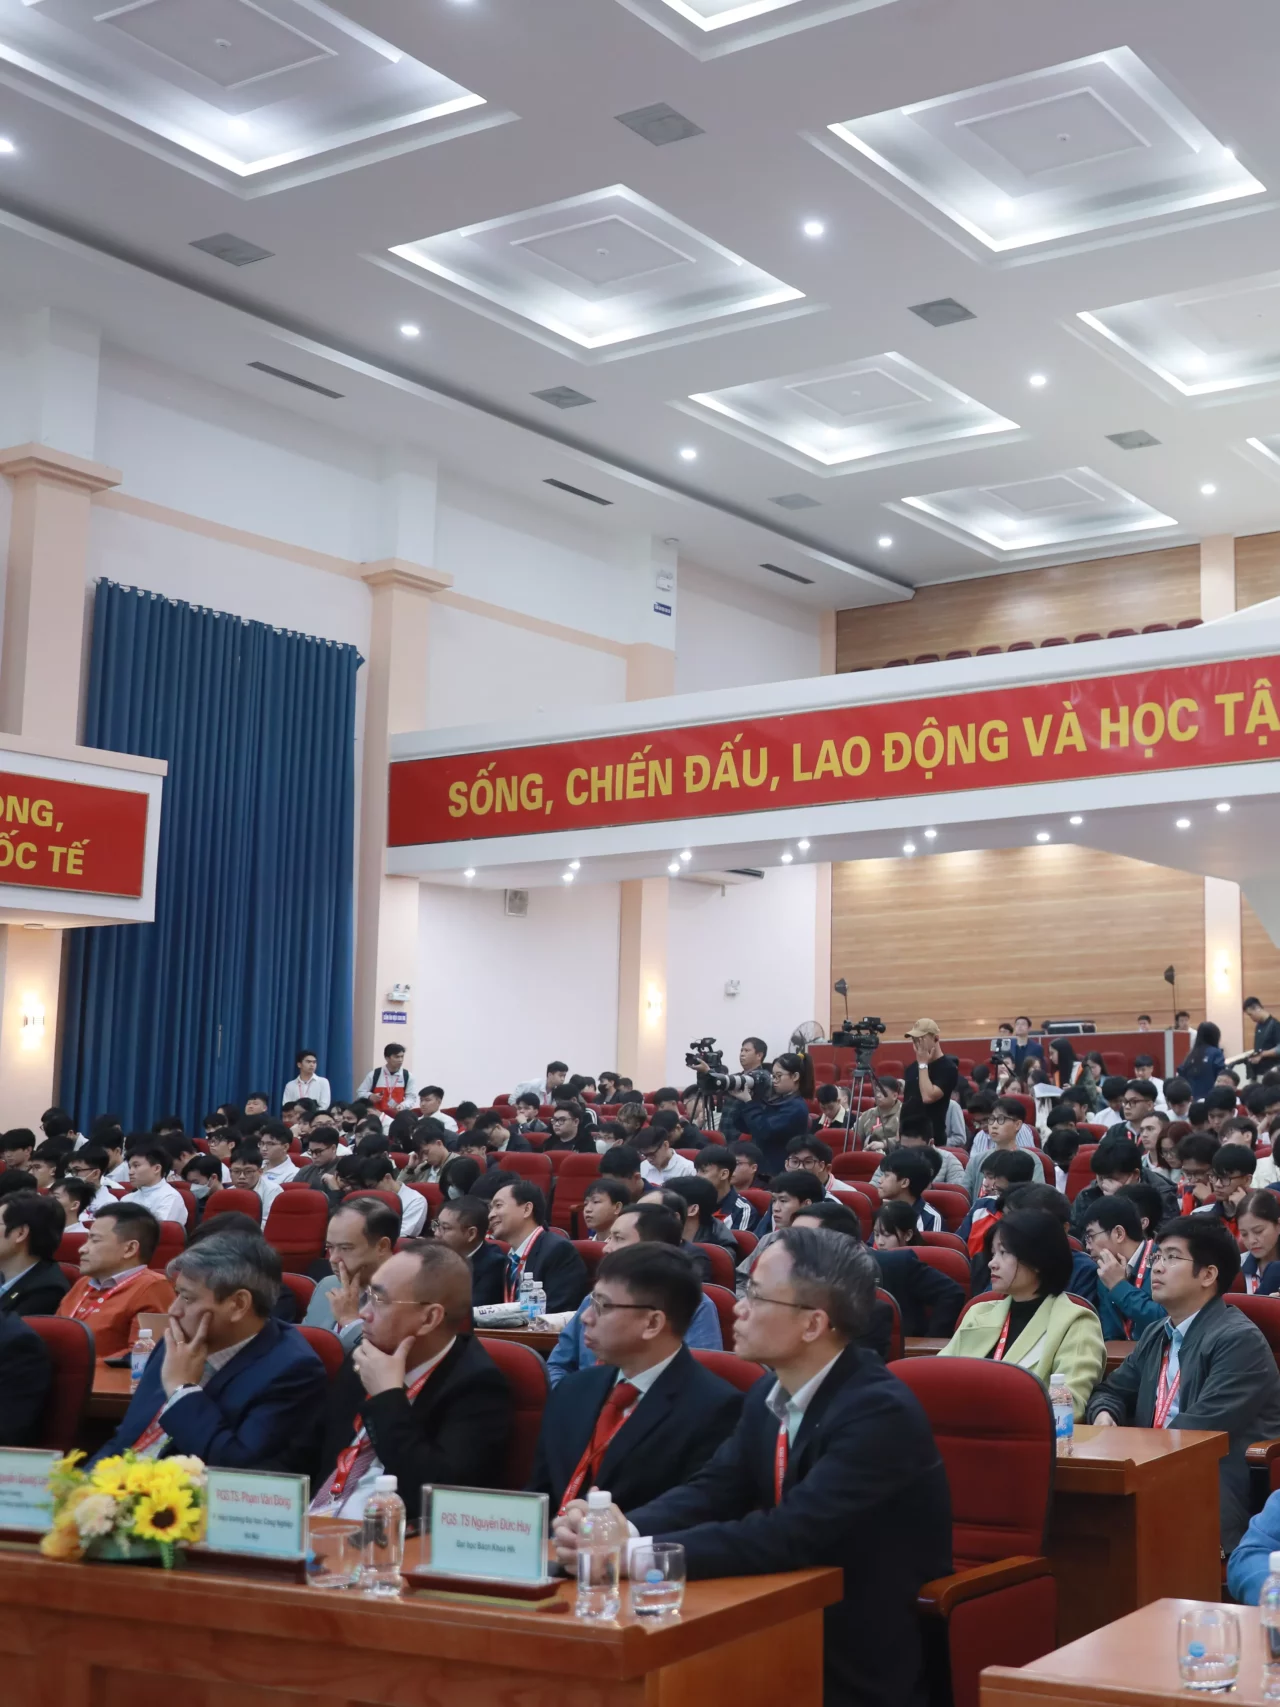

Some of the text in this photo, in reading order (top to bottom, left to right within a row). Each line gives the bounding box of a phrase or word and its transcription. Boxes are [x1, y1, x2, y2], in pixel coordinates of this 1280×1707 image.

[449, 761, 553, 816] SỐNG,
[566, 744, 672, 805] CHIẾN
[684, 735, 779, 792] ĐẤU,
[793, 736, 871, 781] LAO
[882, 717, 1009, 779] ĐỘNG
[1023, 701, 1087, 756] VÀ
[1101, 698, 1198, 757] HỌC
[0, 795, 63, 832] NG,
[48, 839, 91, 876] TẾ
